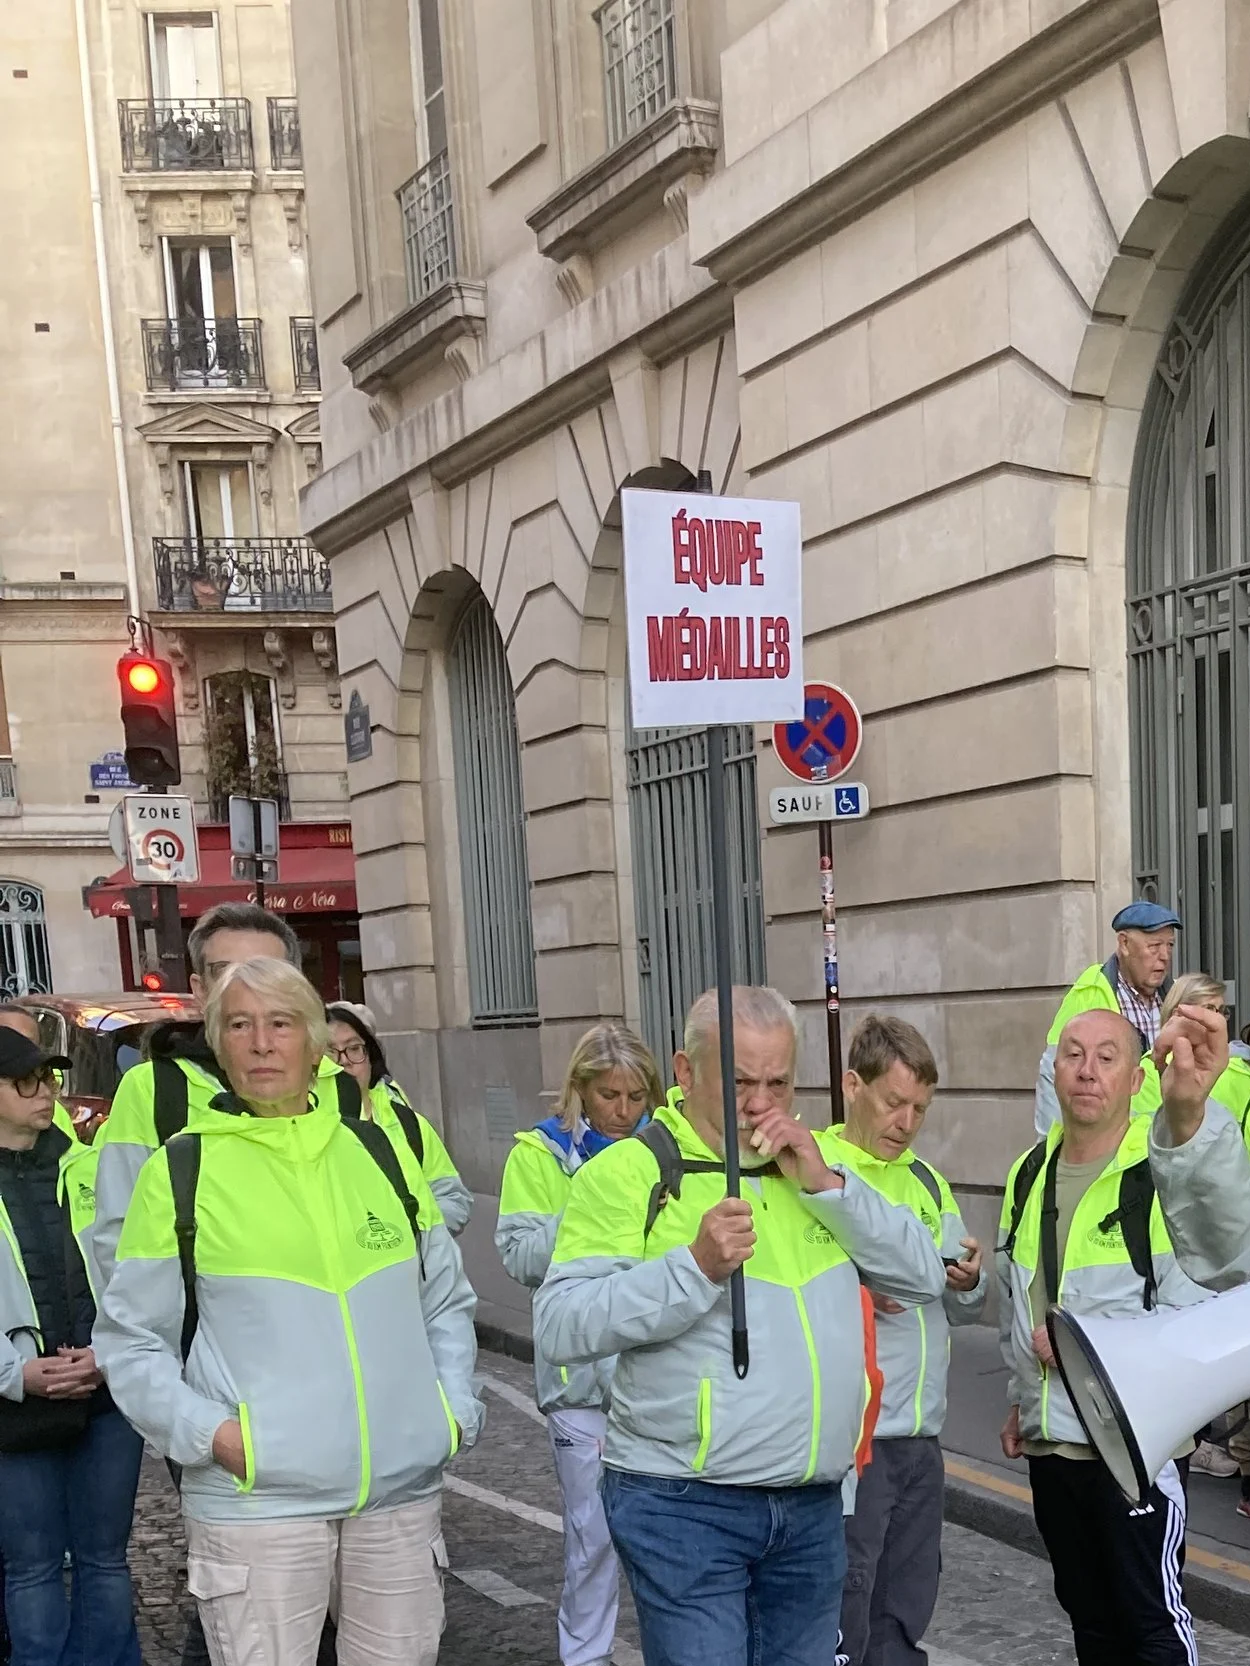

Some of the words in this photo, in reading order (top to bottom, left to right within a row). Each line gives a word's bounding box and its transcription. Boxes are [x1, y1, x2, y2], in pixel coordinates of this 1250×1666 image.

[672, 508, 764, 592] ÉQUIPE
[647, 607, 790, 682] MÉDAILLES
[138, 806, 181, 819] ZONE
[150, 841, 176, 859] 30
